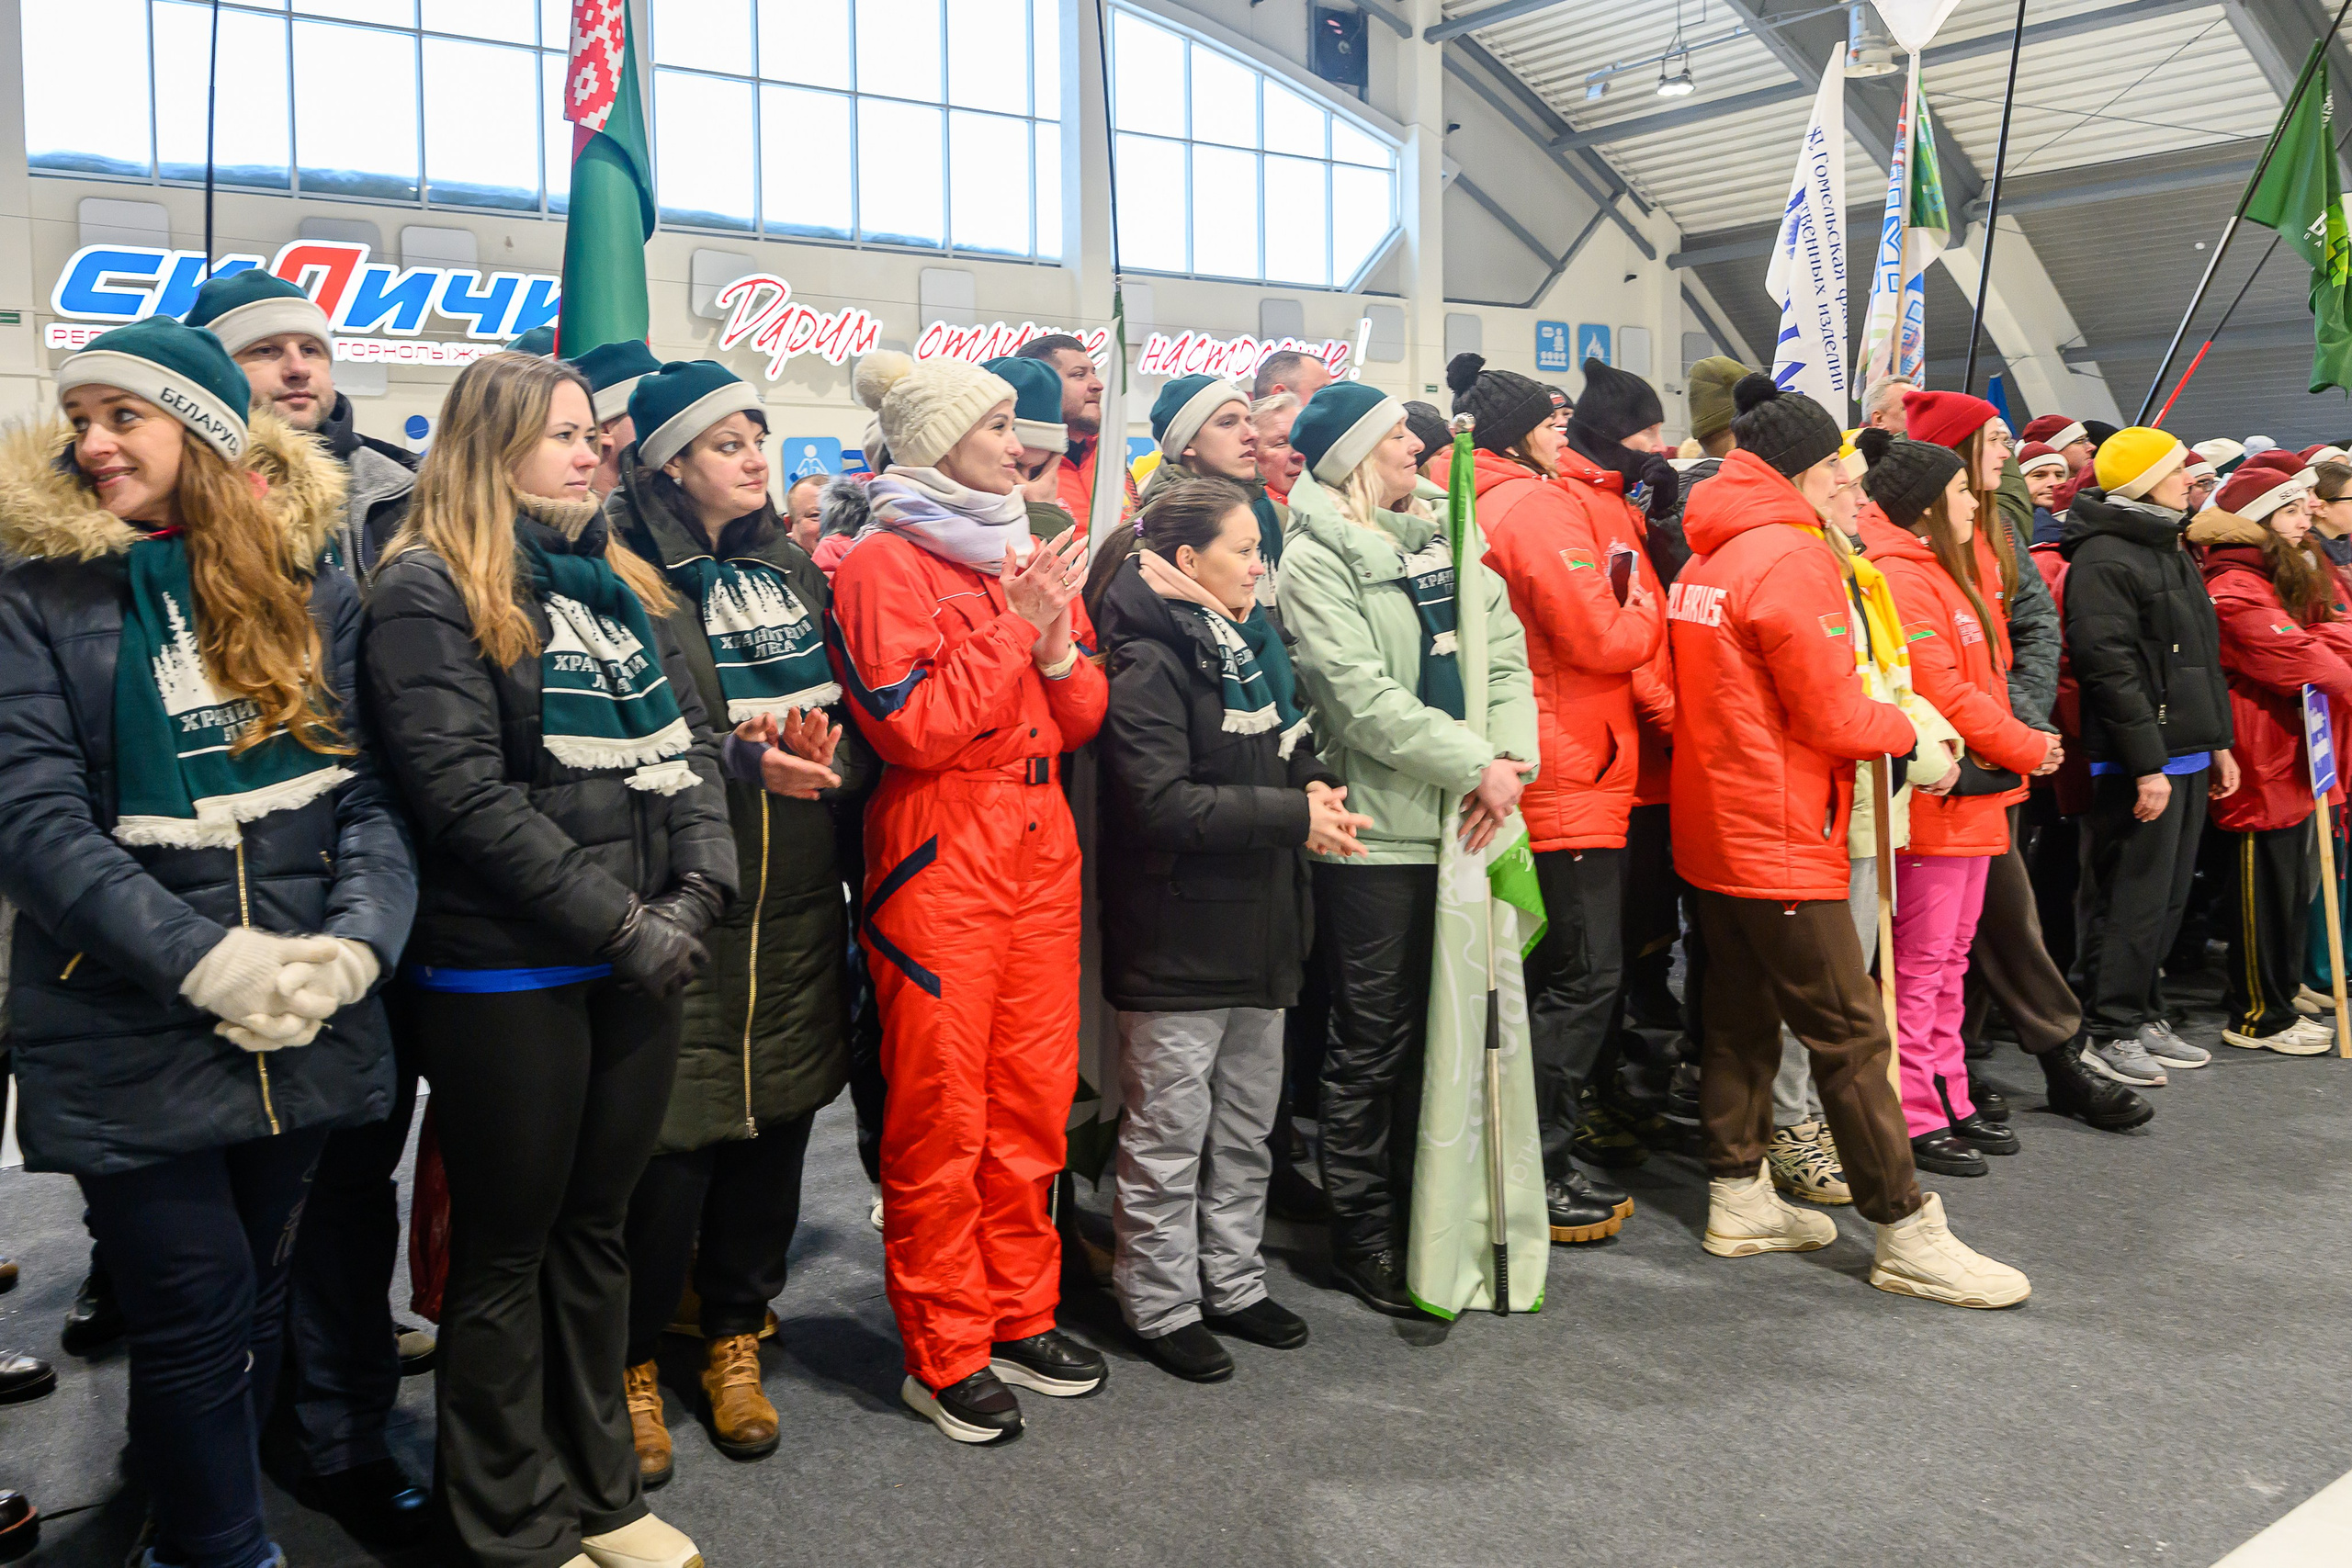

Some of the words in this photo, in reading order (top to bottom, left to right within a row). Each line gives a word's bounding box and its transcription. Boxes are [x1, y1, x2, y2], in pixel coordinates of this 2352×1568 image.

[1812, 152, 1846, 280] Гомельская
[722, 278, 877, 375] Дарим
[1818, 303, 1845, 391] изделий
